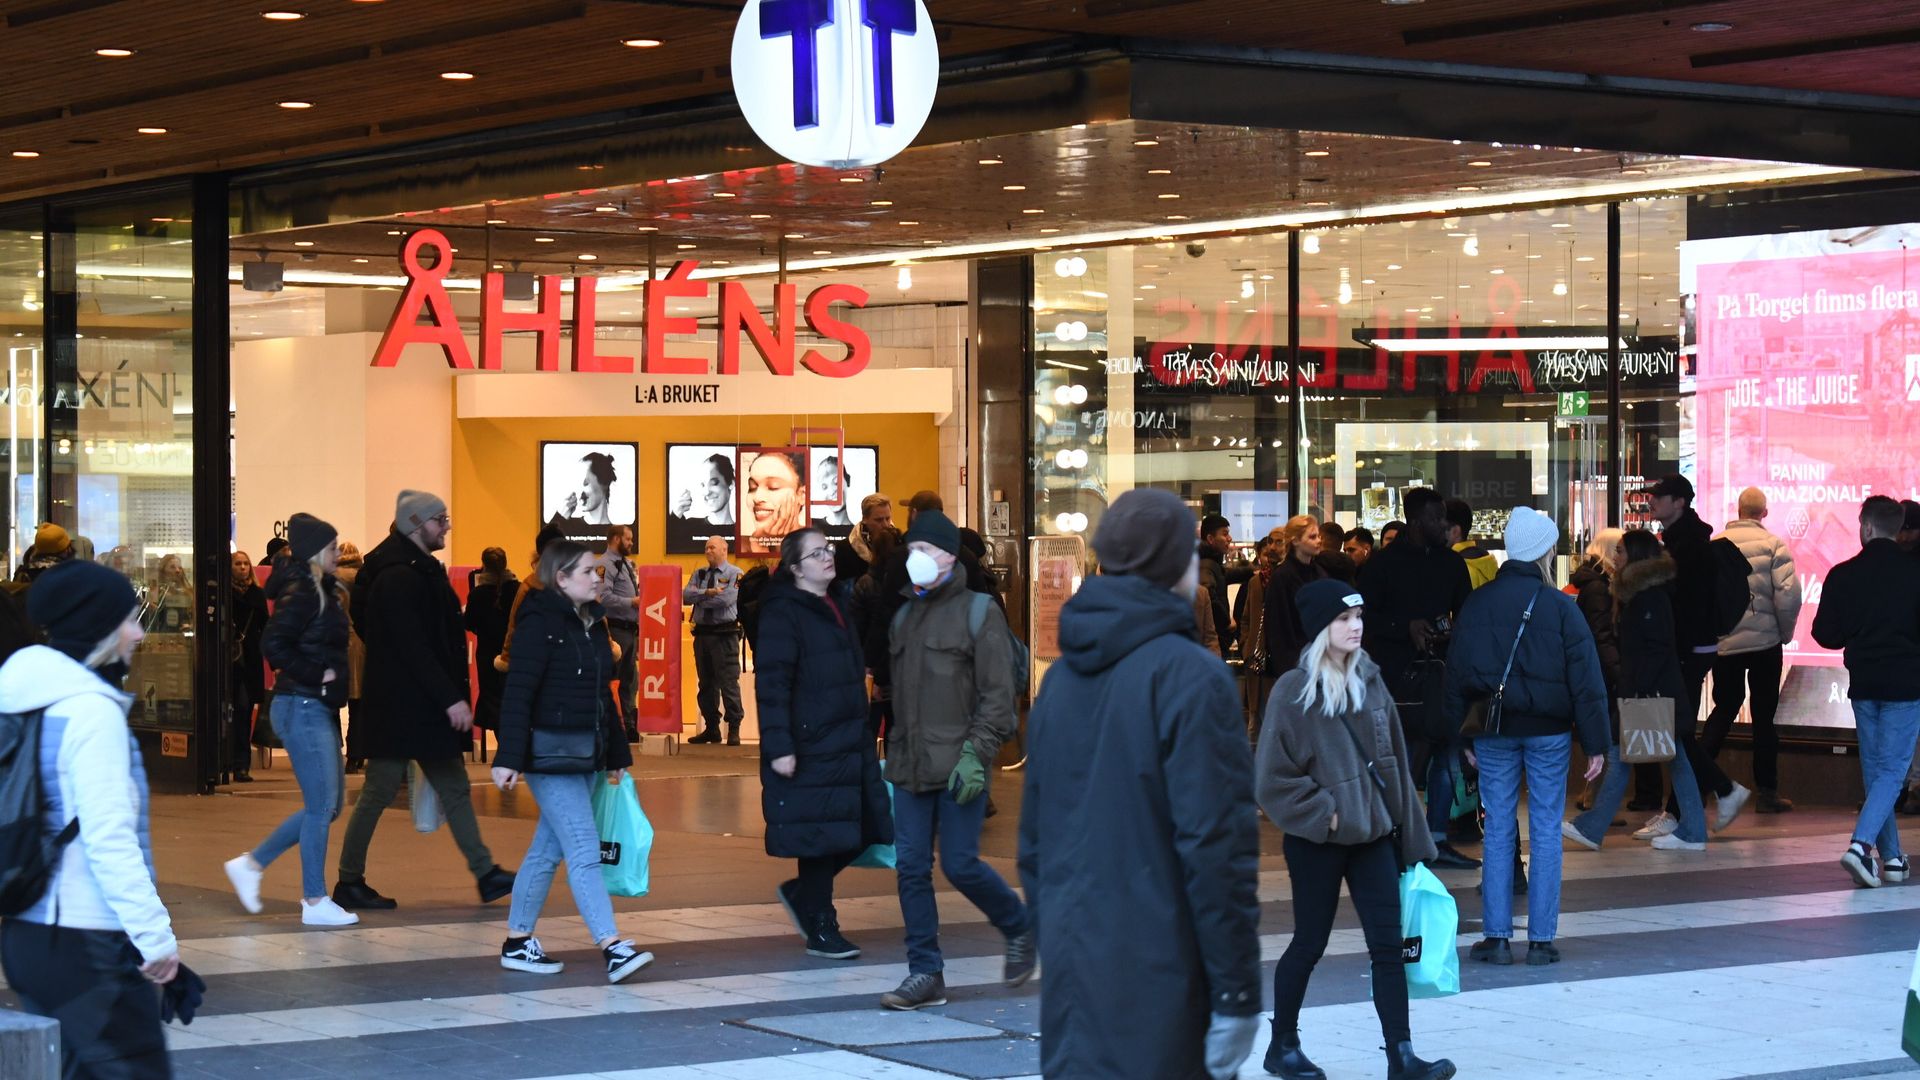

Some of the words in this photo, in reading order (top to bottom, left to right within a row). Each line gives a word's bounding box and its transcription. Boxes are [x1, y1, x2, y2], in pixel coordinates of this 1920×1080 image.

[370, 229, 871, 378] ÅHLÉNS
[1717, 294, 1742, 320] På
[1745, 292, 1810, 323] Torget
[1814, 288, 1867, 315] finns
[1870, 284, 1919, 311] flera
[635, 384, 658, 404] L:A
[662, 384, 720, 404] BRUKET
[1731, 378, 1761, 408] JOE
[1776, 376, 1807, 406] THE
[1811, 374, 1859, 405] JUICE
[1770, 463, 1825, 481] PANINI
[1451, 481, 1517, 498] LIBRE
[644, 596, 667, 700] REA
[1623, 729, 1676, 755] ZARA
